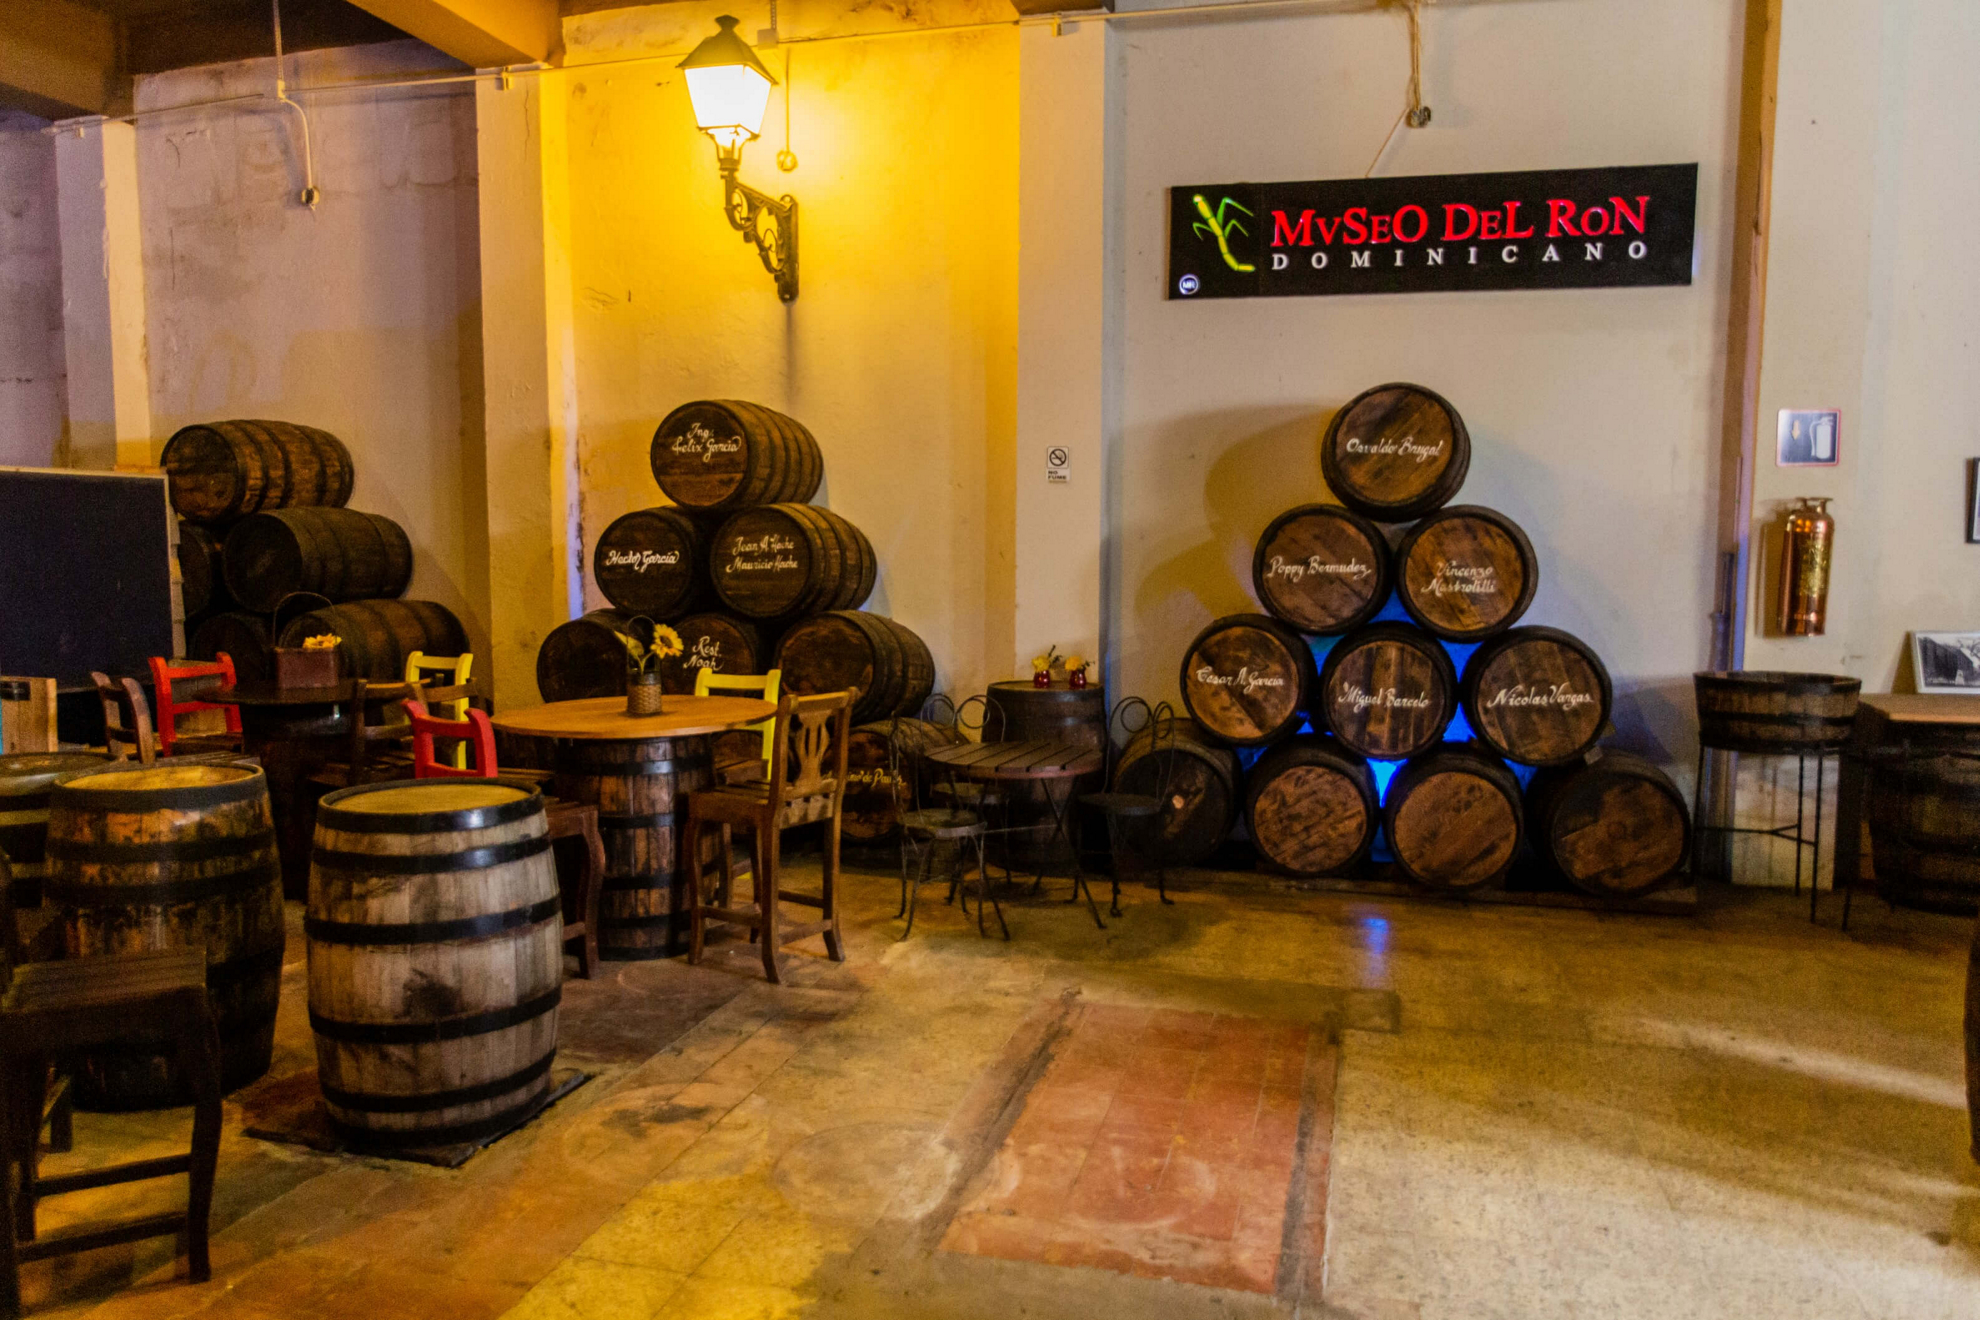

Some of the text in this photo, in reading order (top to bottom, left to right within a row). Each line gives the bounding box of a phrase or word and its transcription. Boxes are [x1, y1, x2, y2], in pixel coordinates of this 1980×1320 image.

[1545, 195, 1650, 238] RON
[1271, 240, 1648, 270] DOMINICANO
[1266, 555, 1305, 583] Poppy
[1337, 681, 1383, 714] Miguel
[1548, 681, 1594, 712] Vargas
